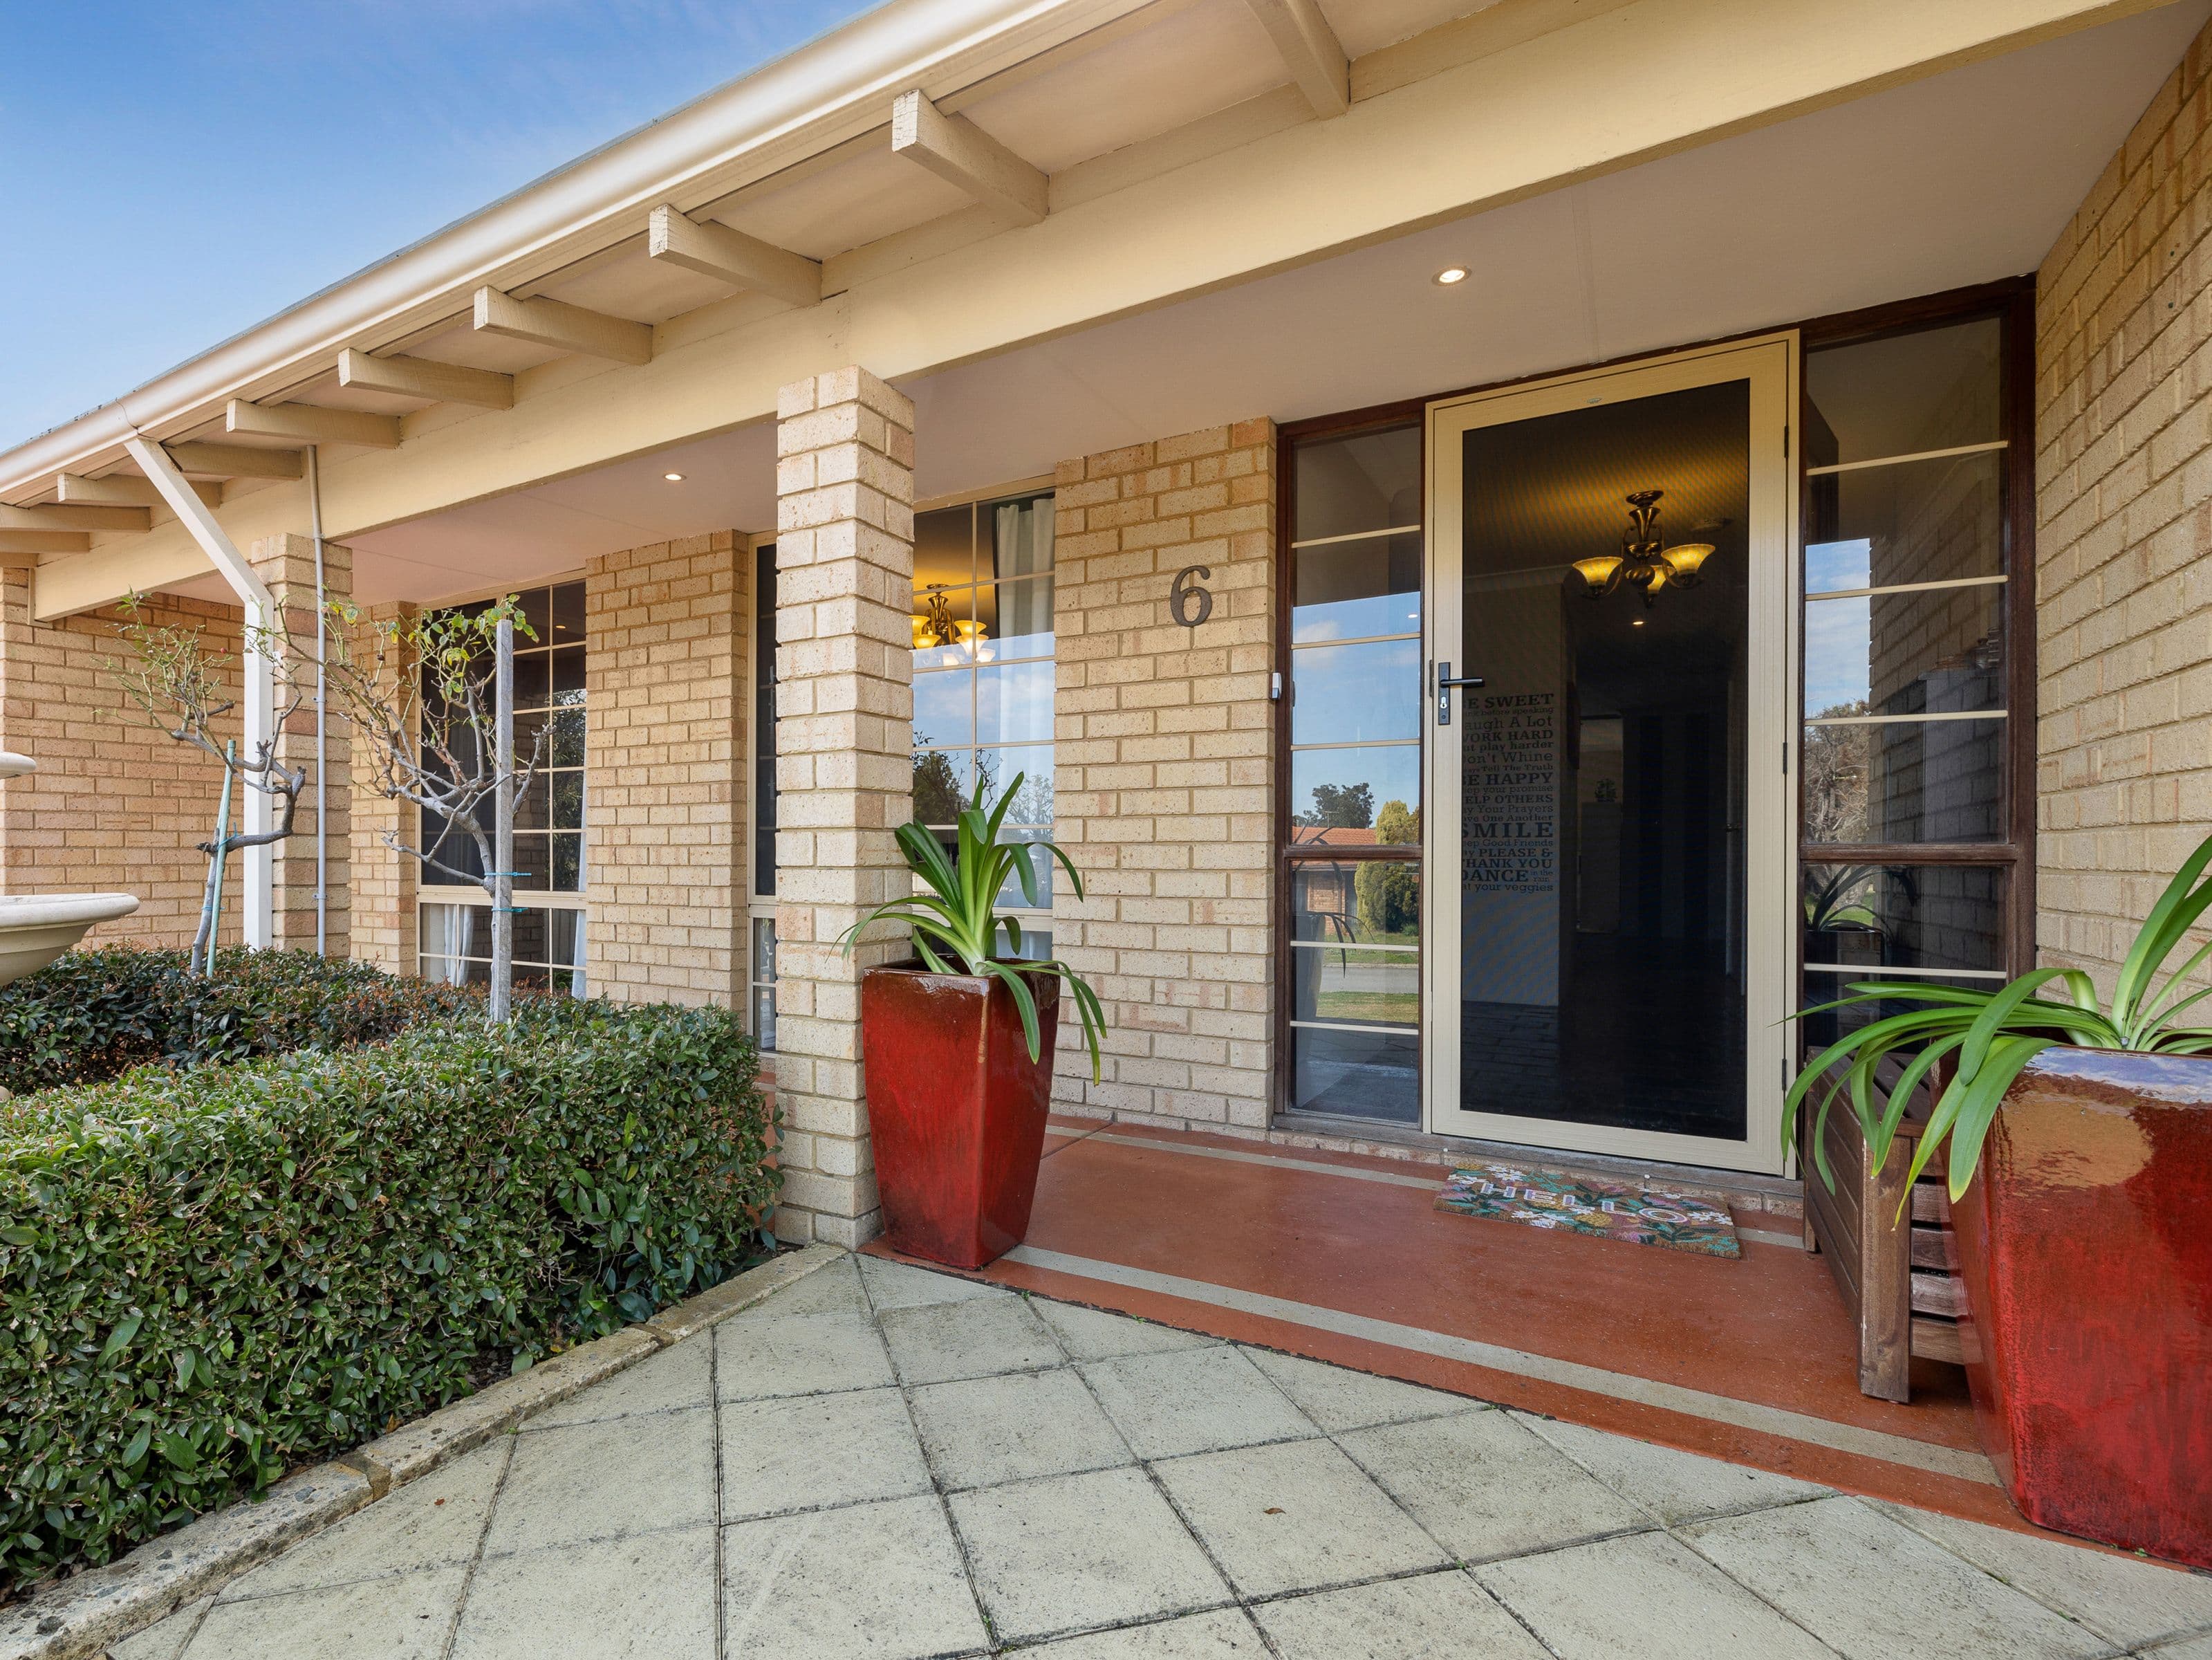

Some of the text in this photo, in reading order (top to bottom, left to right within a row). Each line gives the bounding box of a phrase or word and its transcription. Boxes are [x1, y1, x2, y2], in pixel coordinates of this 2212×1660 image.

[1170, 564, 1212, 627] 6
[1462, 694, 1554, 709] E SWEET
[1512, 706, 1554, 715] speaking
[1465, 715, 1552, 732] augh A Lot
[1508, 730, 1554, 741] HARD
[1479, 742, 1505, 753] play
[1509, 741, 1554, 750] harder
[1464, 751, 1554, 764] on't Whine
[1462, 772, 1554, 786] E HAPPY
[1483, 786, 1505, 795] your
[1509, 784, 1554, 795] promise
[1463, 794, 1554, 804] ELP OTHERS
[1477, 804, 1505, 813] Your
[1508, 804, 1554, 815] Prayers
[1505, 813, 1554, 822] Another
[1482, 838, 1511, 847] Good
[1514, 838, 1554, 847] Friends
[1478, 847, 1536, 858] PLEASE
[1541, 847, 1553, 858] &
[1462, 858, 1552, 869] HANK YOU
[1474, 883, 1501, 893] your
[1505, 882, 1554, 895] veggies
[1478, 1182, 1689, 1224] HELLO
